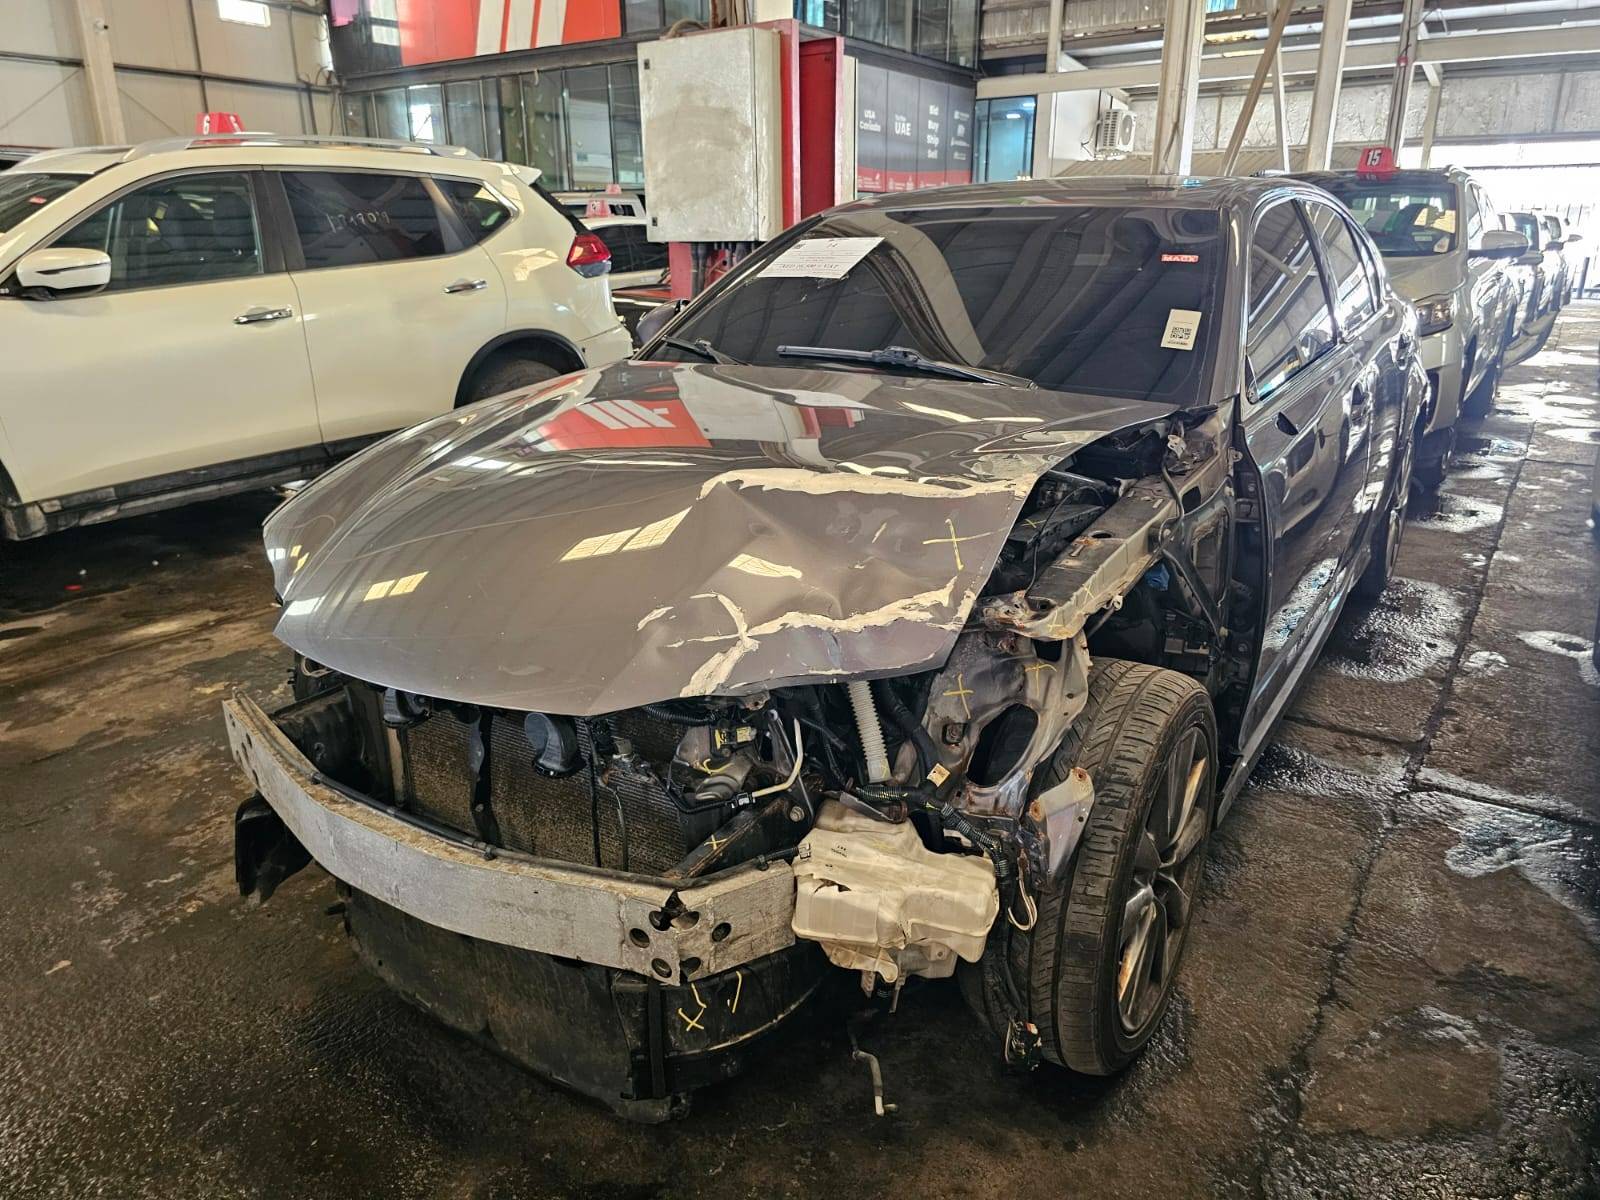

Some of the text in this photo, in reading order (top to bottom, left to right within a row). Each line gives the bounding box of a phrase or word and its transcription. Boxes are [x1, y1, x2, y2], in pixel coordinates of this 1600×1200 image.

[203, 114, 210, 135] 6
[895, 122, 911, 136] UAE
[927, 135, 939, 147] Ship
[1366, 149, 1382, 166] 15
